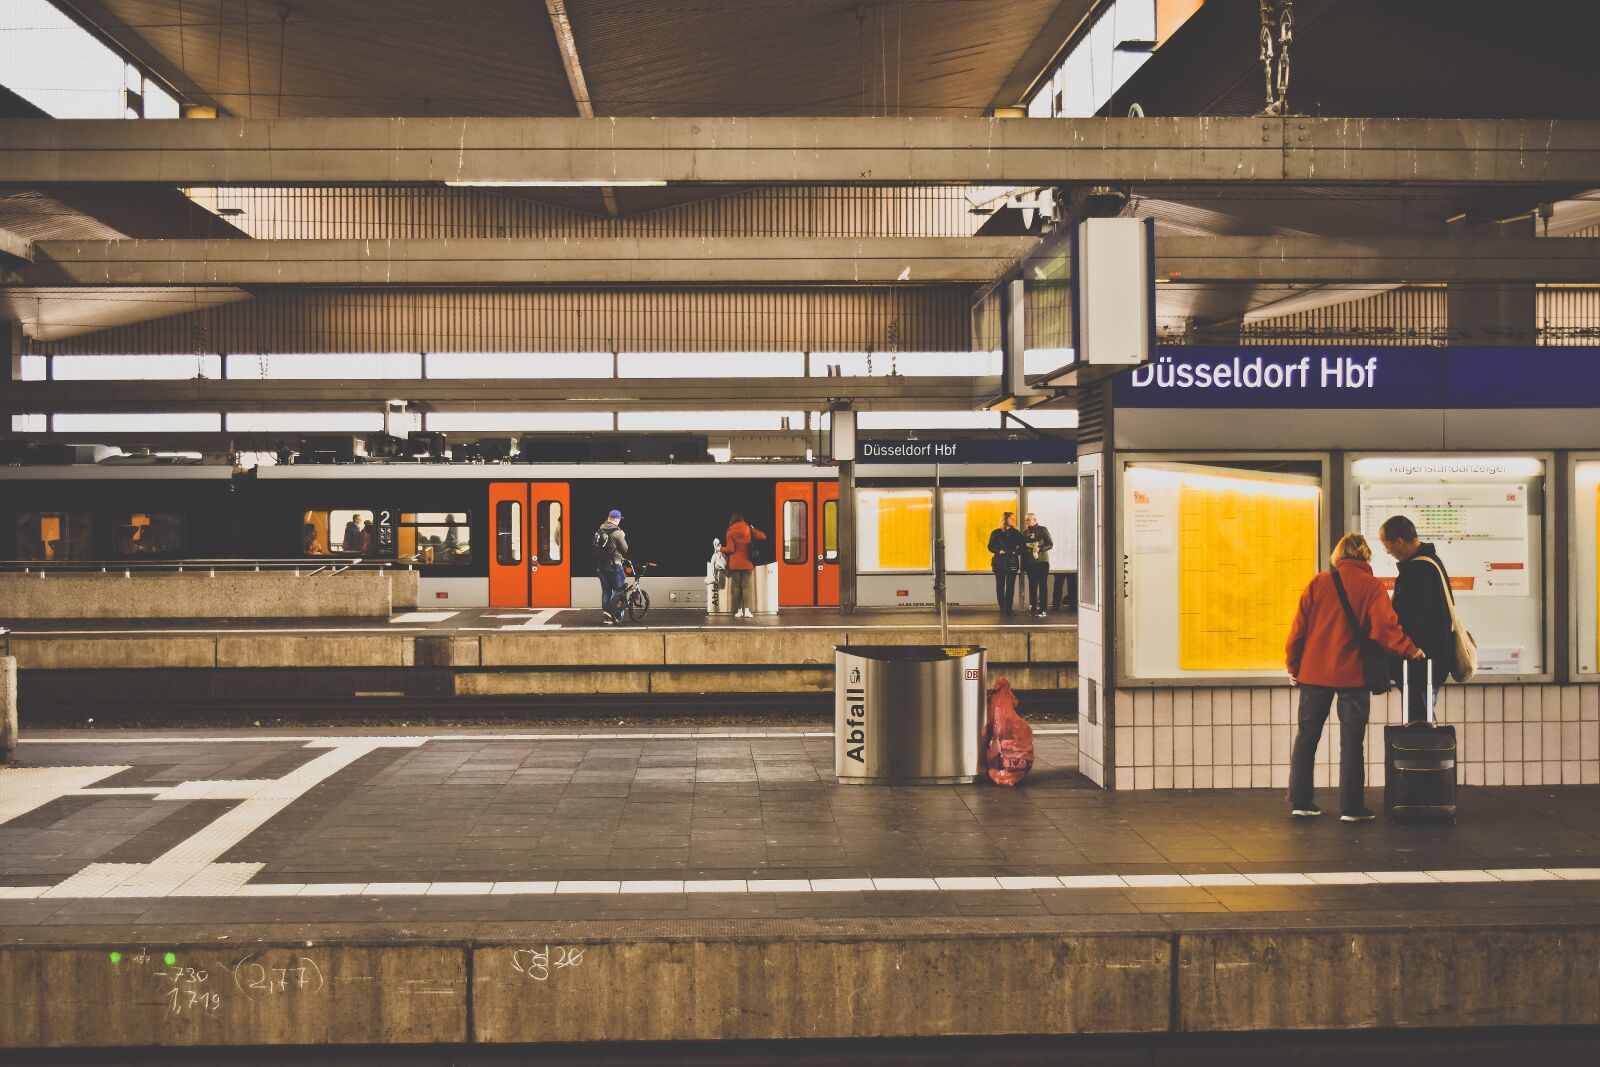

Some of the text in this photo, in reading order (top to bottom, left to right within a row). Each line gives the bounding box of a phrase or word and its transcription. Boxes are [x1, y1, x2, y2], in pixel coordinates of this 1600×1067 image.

[1132, 356, 1378, 389] Düsseldorf Hbf
[864, 443, 957, 456] Düsseldorf Hbf
[380, 510, 391, 526] 2
[966, 670, 979, 680] DB
[846, 688, 865, 764] Abfall
